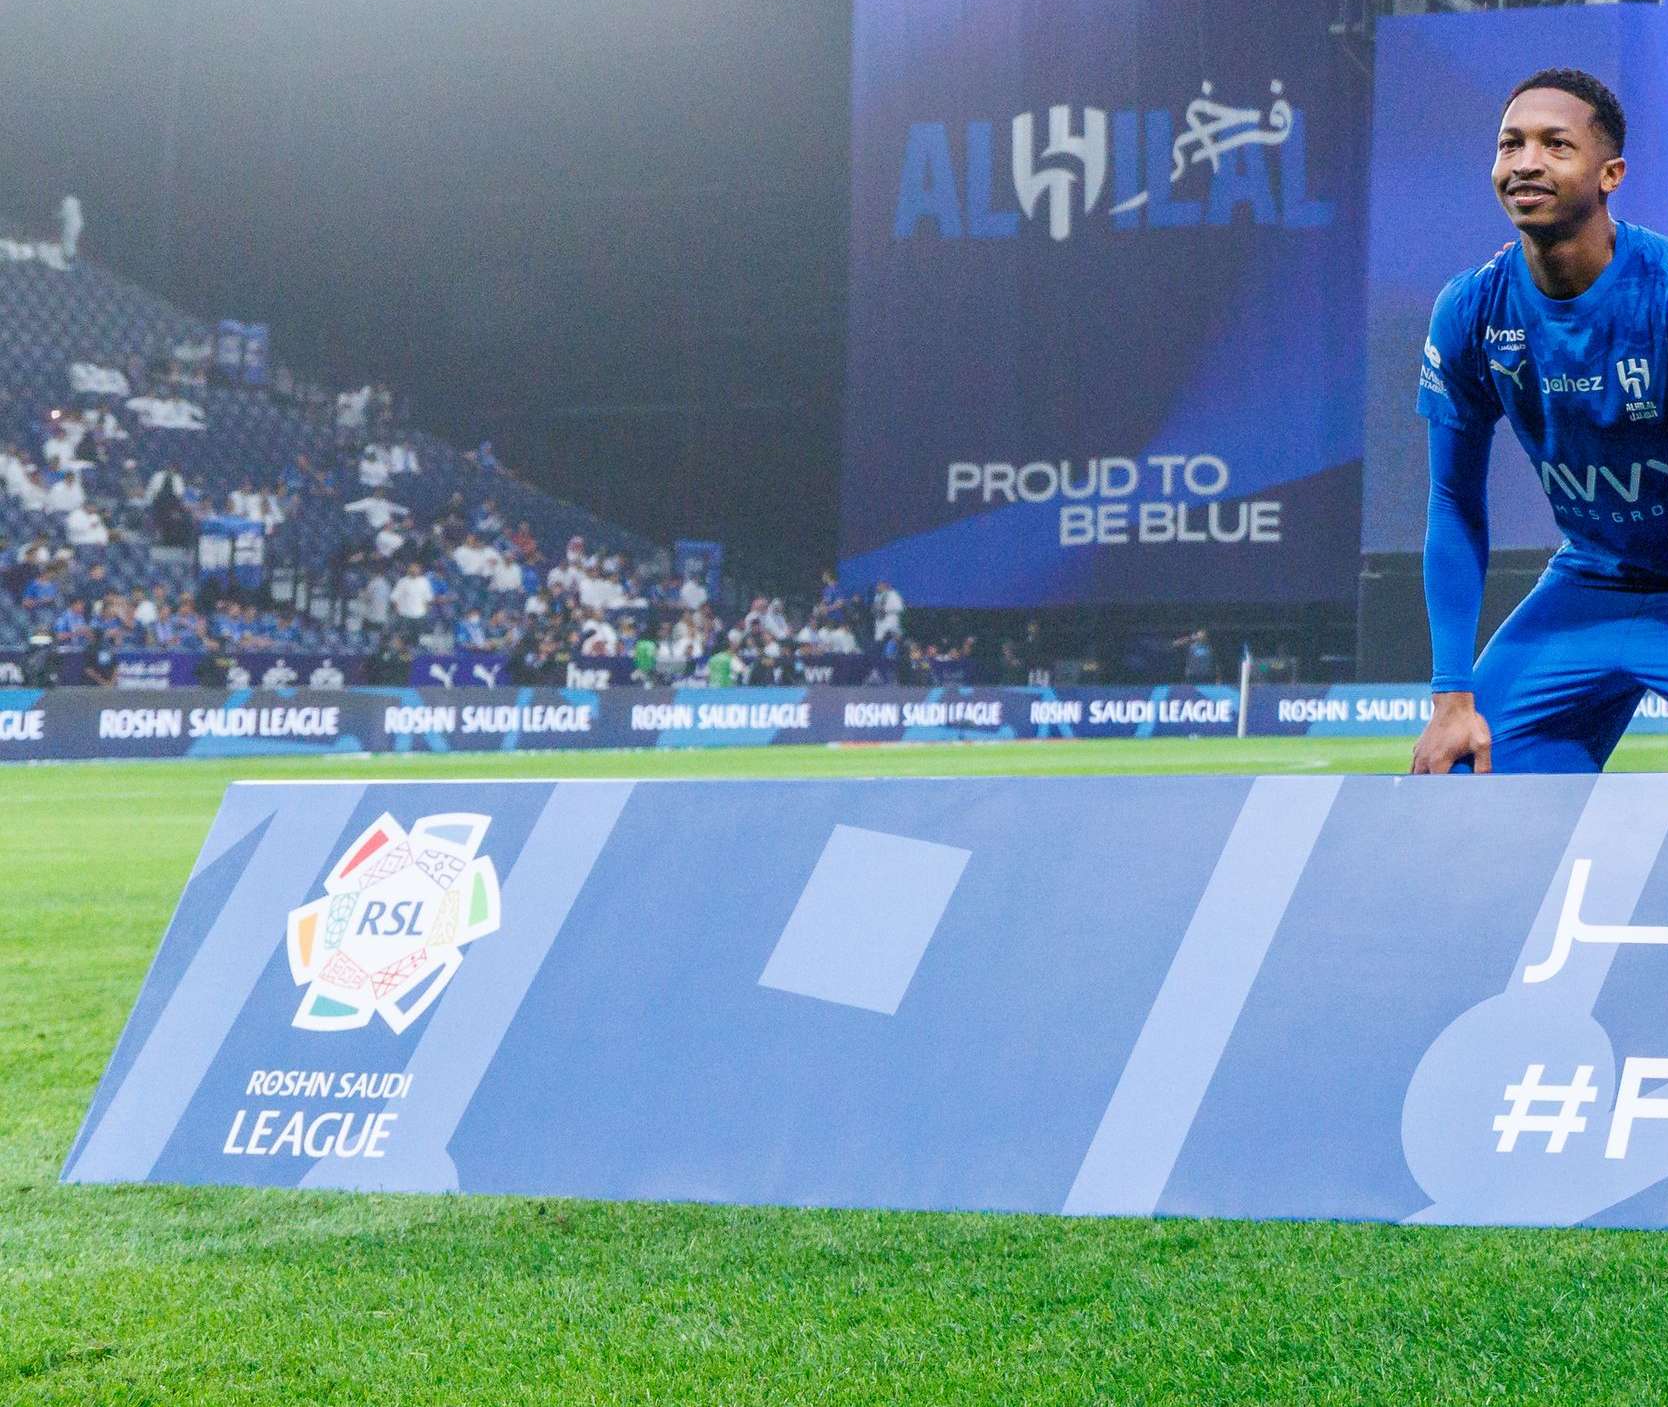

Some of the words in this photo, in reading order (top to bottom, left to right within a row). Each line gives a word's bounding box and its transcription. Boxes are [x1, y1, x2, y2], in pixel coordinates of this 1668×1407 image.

[1485, 325, 1526, 343] lynas
[947, 457, 1139, 502] PROUD
[1147, 455, 1228, 495] TO
[1058, 503, 1129, 546] BE
[1138, 501, 1282, 542] BLUE
[1555, 504, 1600, 521] MES
[566, 662, 611, 690] hez
[100, 709, 182, 739] ROSHN
[189, 708, 255, 738] SAUDI
[259, 707, 340, 737] LEAGUE
[385, 706, 455, 734] ROSHN
[462, 706, 520, 734] SAUDI
[523, 705, 592, 732] LEAGUE
[632, 704, 693, 730] ROSHN
[699, 704, 747, 730] SAUDI
[750, 703, 811, 729] LEAGUE
[1030, 701, 1082, 724] ROSHN
[1089, 699, 1151, 723] SAUDI
[1159, 699, 1233, 722] LEAGUE
[1278, 698, 1348, 722] ROSHN
[1356, 698, 1416, 722] SAUDI
[0, 710, 46, 741] GUE
[356, 900, 426, 937] RSL
[246, 1070, 334, 1099] ROSHN
[333, 1072, 412, 1099] SAUDI
[223, 1109, 399, 1158] LEAGUE
